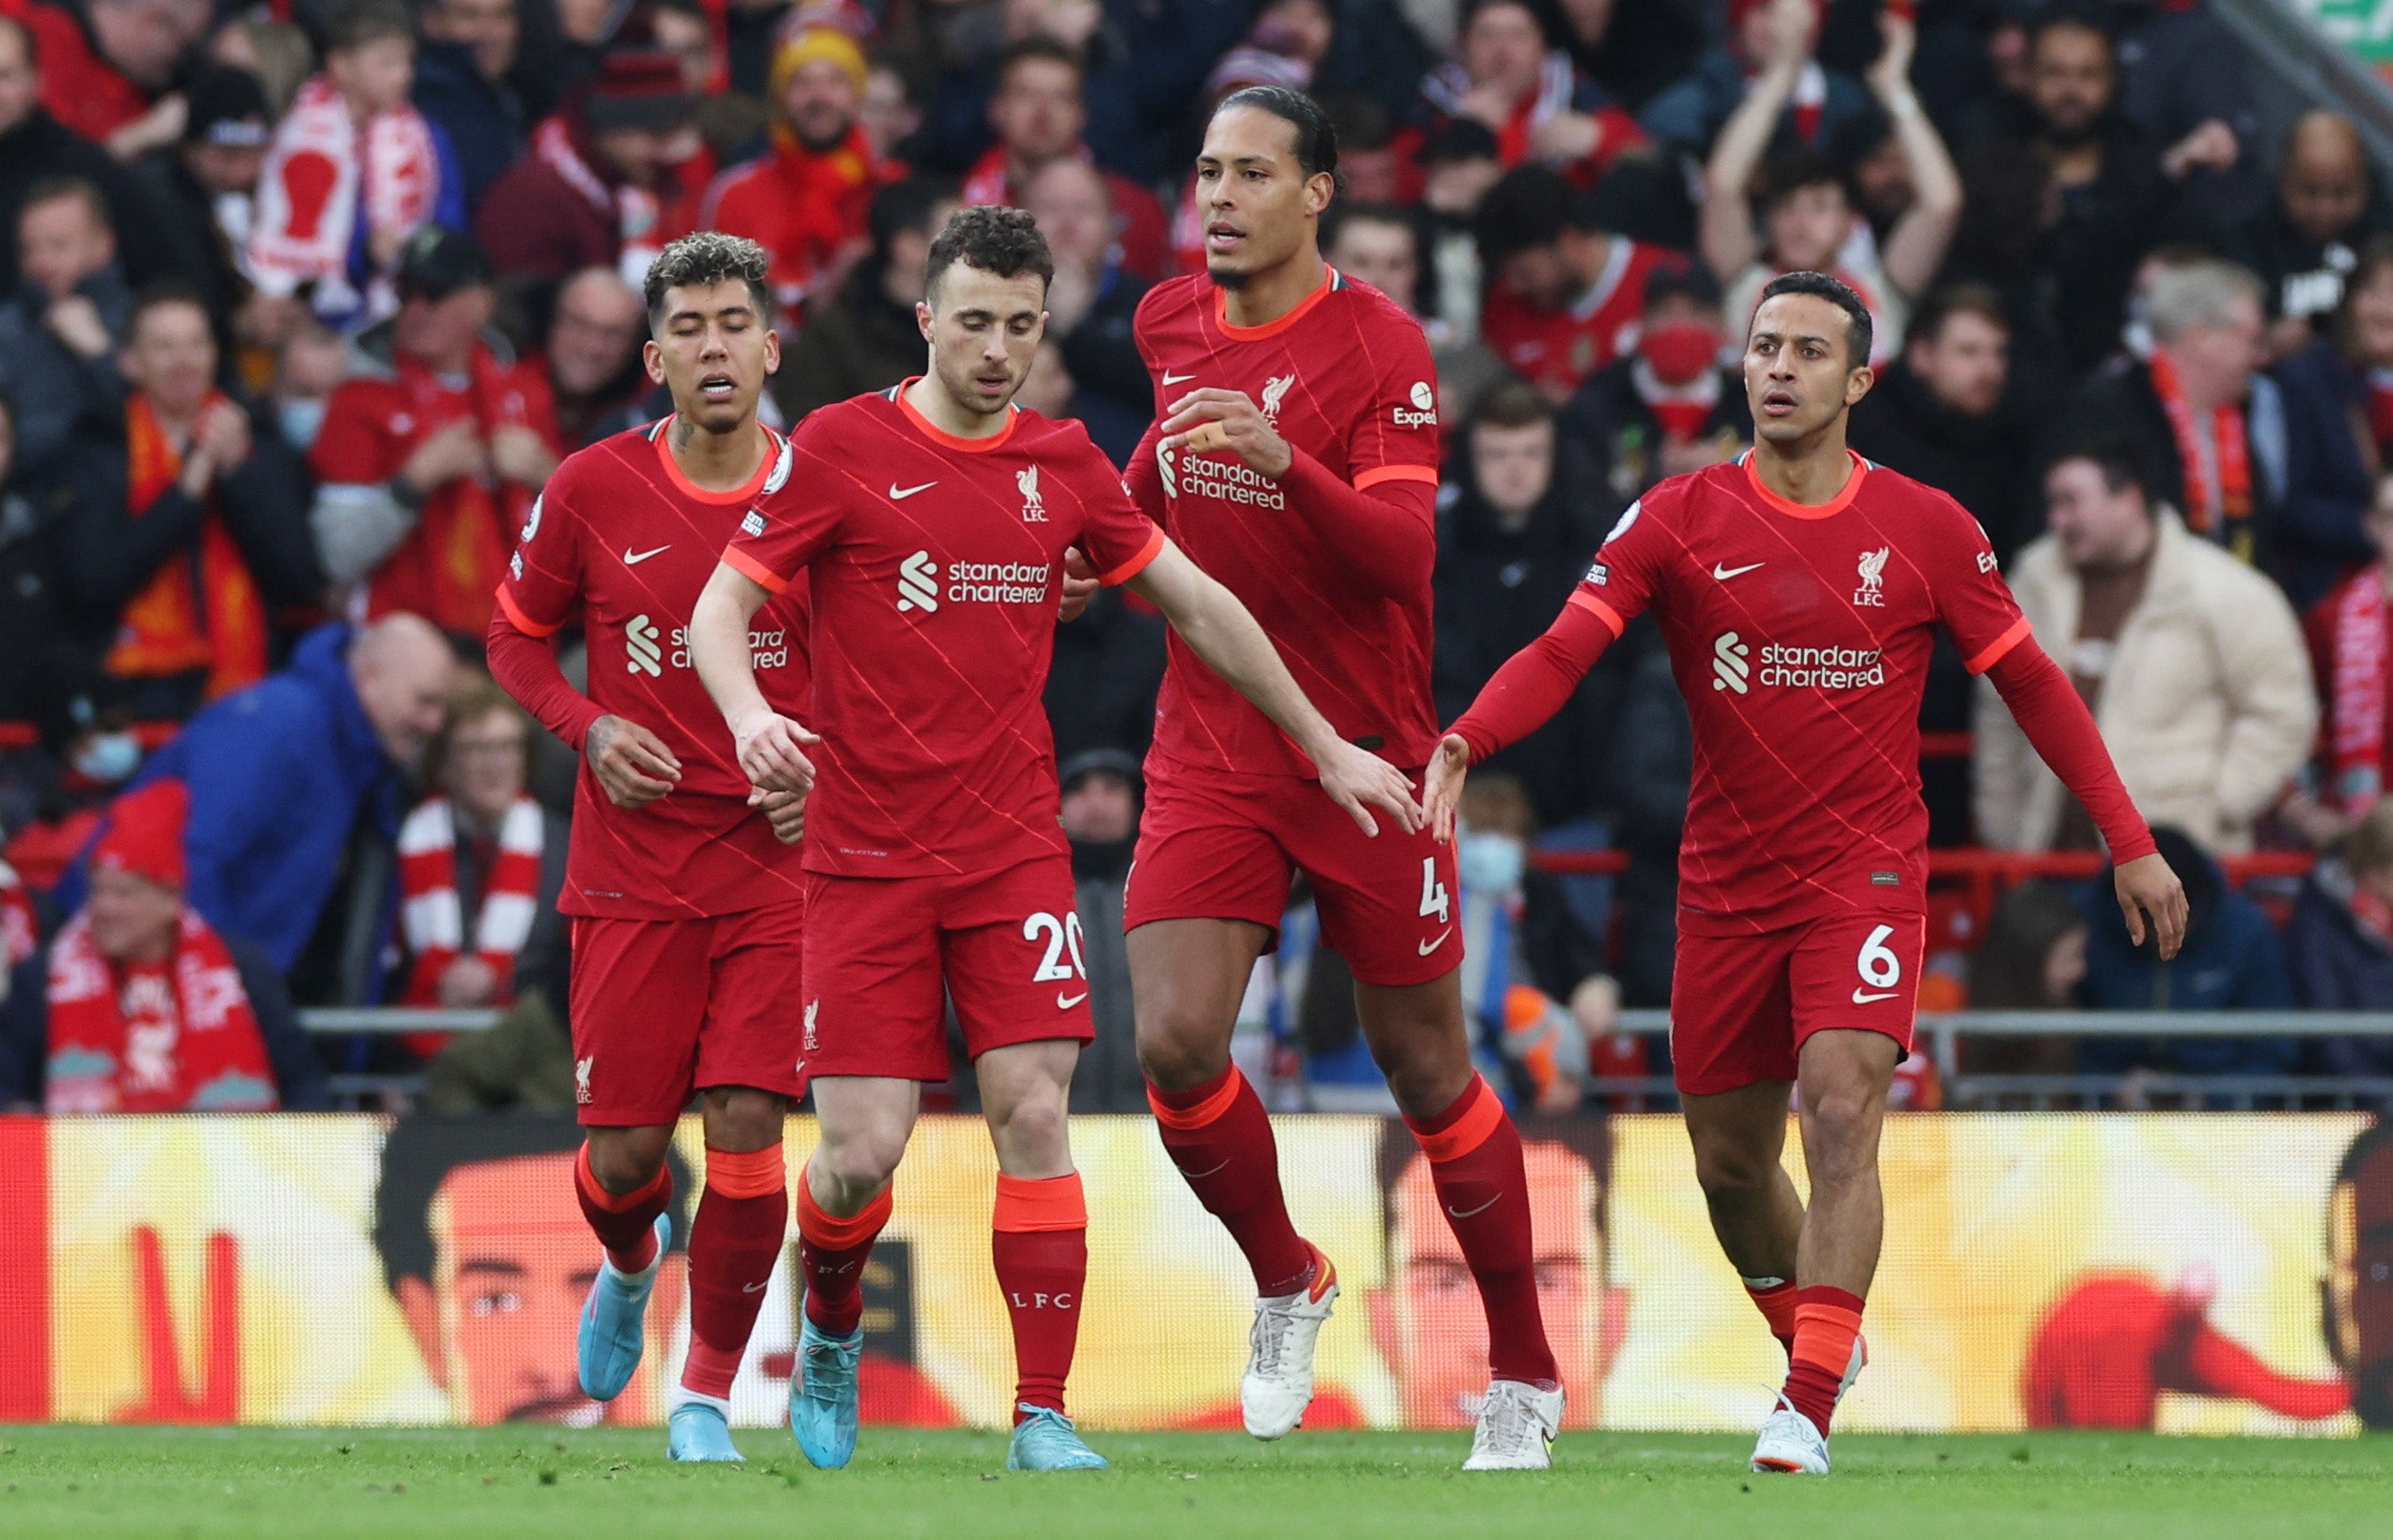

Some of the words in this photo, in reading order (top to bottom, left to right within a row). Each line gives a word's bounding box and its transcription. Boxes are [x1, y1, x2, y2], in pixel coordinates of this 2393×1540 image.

[1181, 475, 1285, 511] chartered
[948, 559, 1050, 583] standard
[947, 580, 1048, 603] chartered
[1760, 642, 1883, 667] standard
[1759, 663, 1885, 689] chartered
[1419, 856, 1450, 924] 4
[1022, 911, 1088, 982] 20
[1856, 923, 1901, 989] 6
